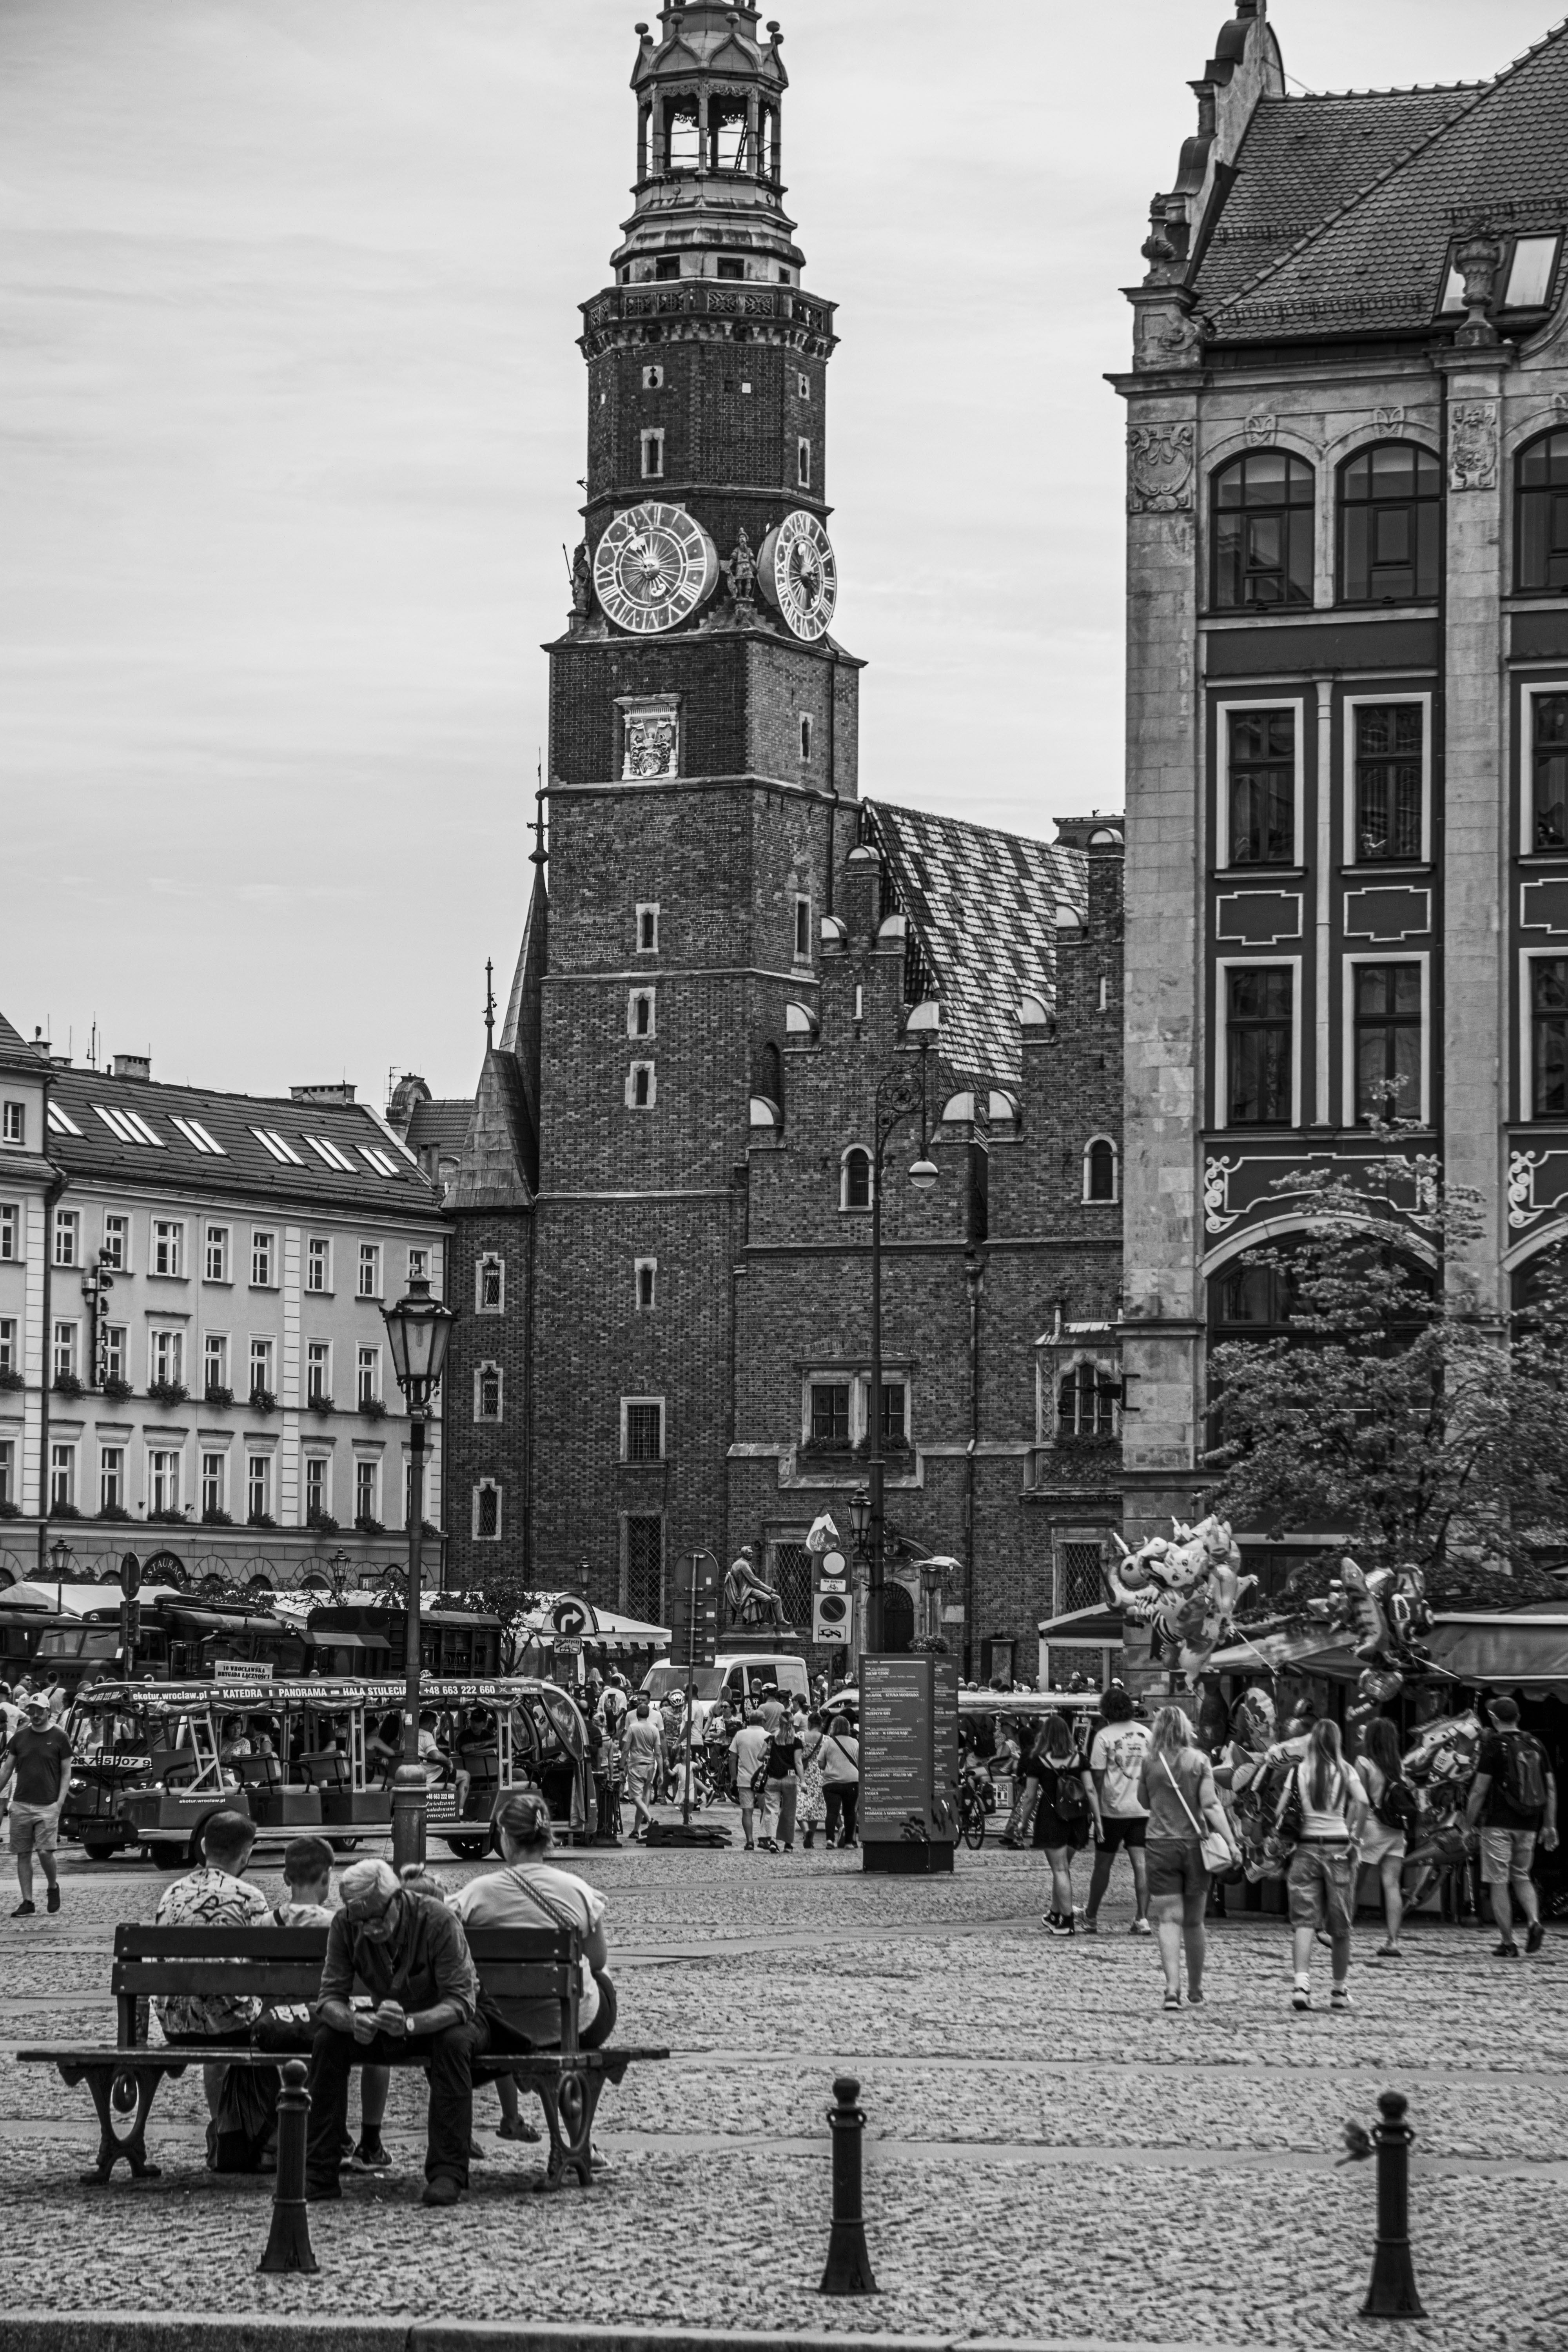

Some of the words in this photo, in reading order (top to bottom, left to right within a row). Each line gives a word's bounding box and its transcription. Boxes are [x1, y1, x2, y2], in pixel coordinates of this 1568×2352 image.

[132, 1690, 207, 1700] ekotur.wroclaw.pl
[223, 1689, 263, 1698] KATEDRA
[278, 1688, 327, 1697] PANORAMA
[343, 1687, 366, 1696] HALA
[424, 1686, 439, 1694] +48
[442, 1686, 458, 1694] 663
[461, 1686, 477, 1694] 222
[479, 1685, 495, 1694] 660
